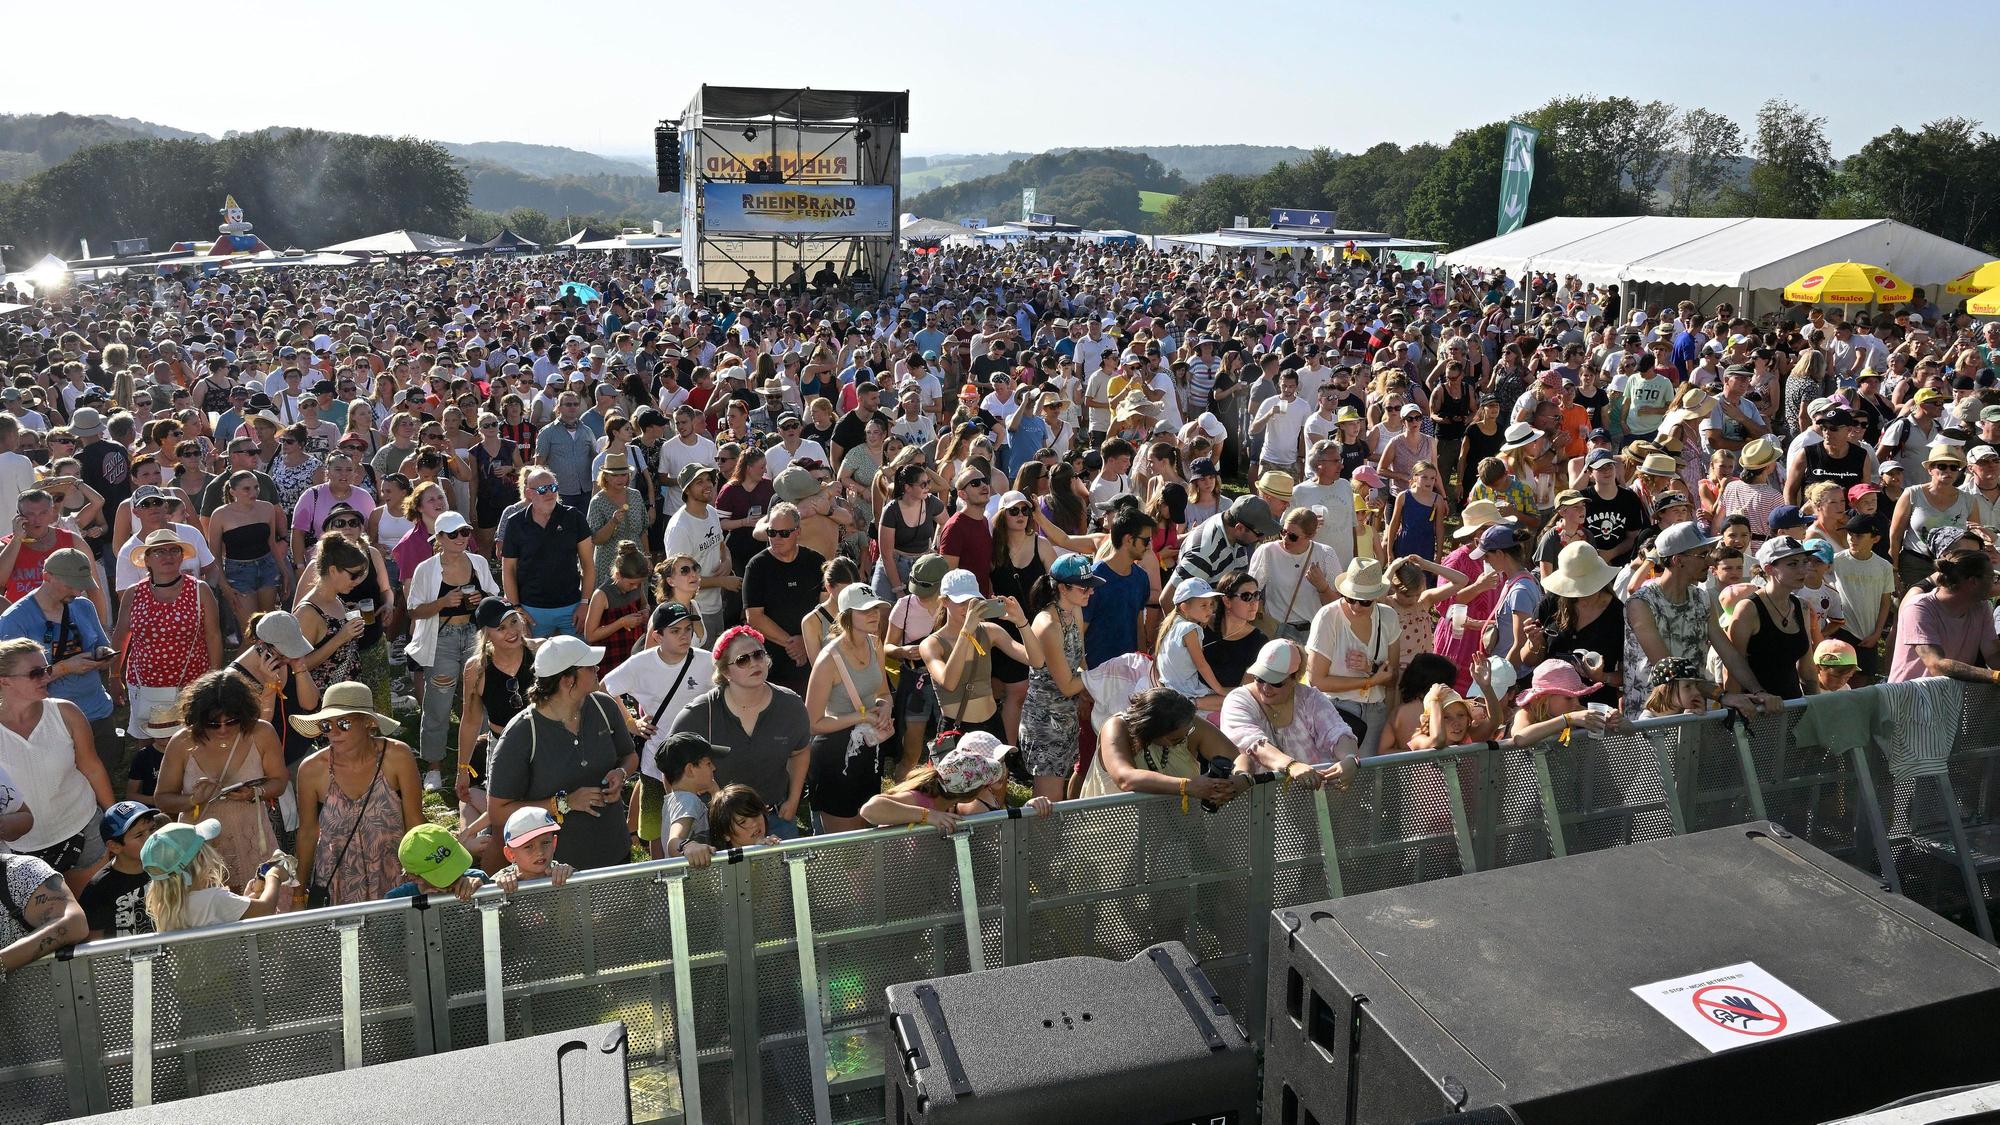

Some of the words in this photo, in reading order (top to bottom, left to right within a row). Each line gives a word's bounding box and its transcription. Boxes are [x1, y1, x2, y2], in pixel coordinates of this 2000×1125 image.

[797, 210, 856, 218] FESTIVAL
[1791, 293, 1814, 301] Sinalco
[1831, 294, 1864, 302] Sinalco
[1812, 468, 1858, 479] Champion
[1586, 511, 1626, 524] KASALLA
[1669, 986, 1684, 994] STOP
[1688, 982, 1706, 990] NICHT
[1706, 974, 1737, 986] BETRETEN
